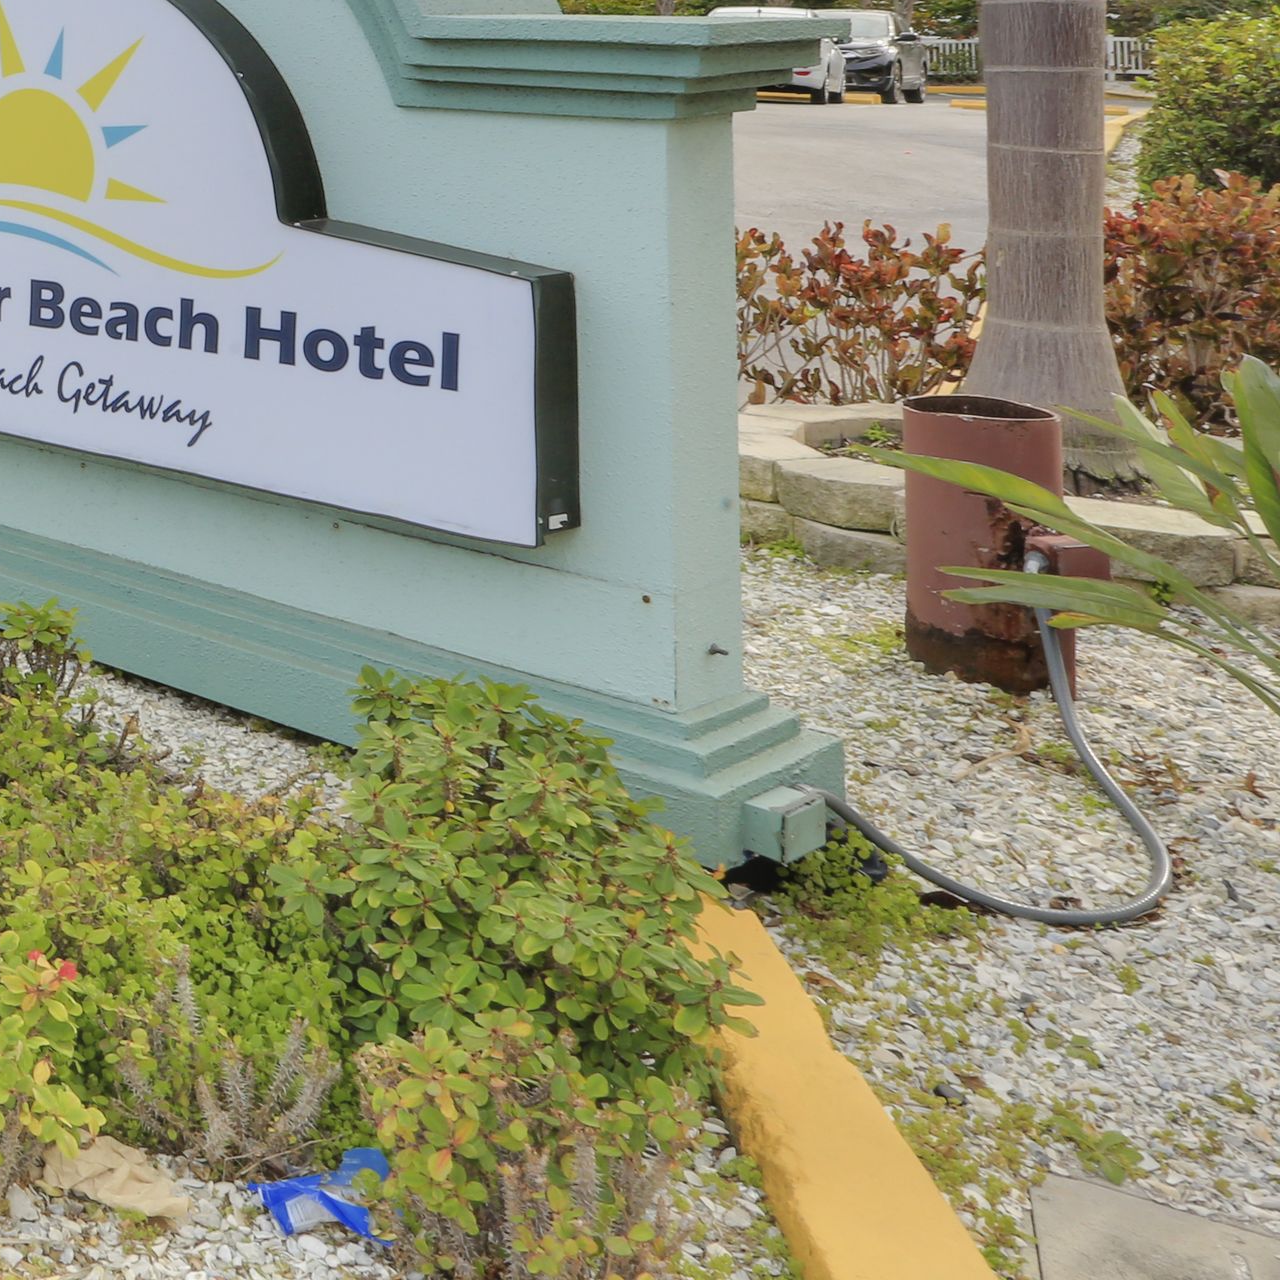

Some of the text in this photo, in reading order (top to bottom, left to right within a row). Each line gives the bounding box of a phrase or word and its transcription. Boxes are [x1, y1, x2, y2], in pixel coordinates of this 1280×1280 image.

[30, 278, 220, 356] Beach
[244, 306, 461, 393] Hotel
[57, 362, 214, 448] Getaway
